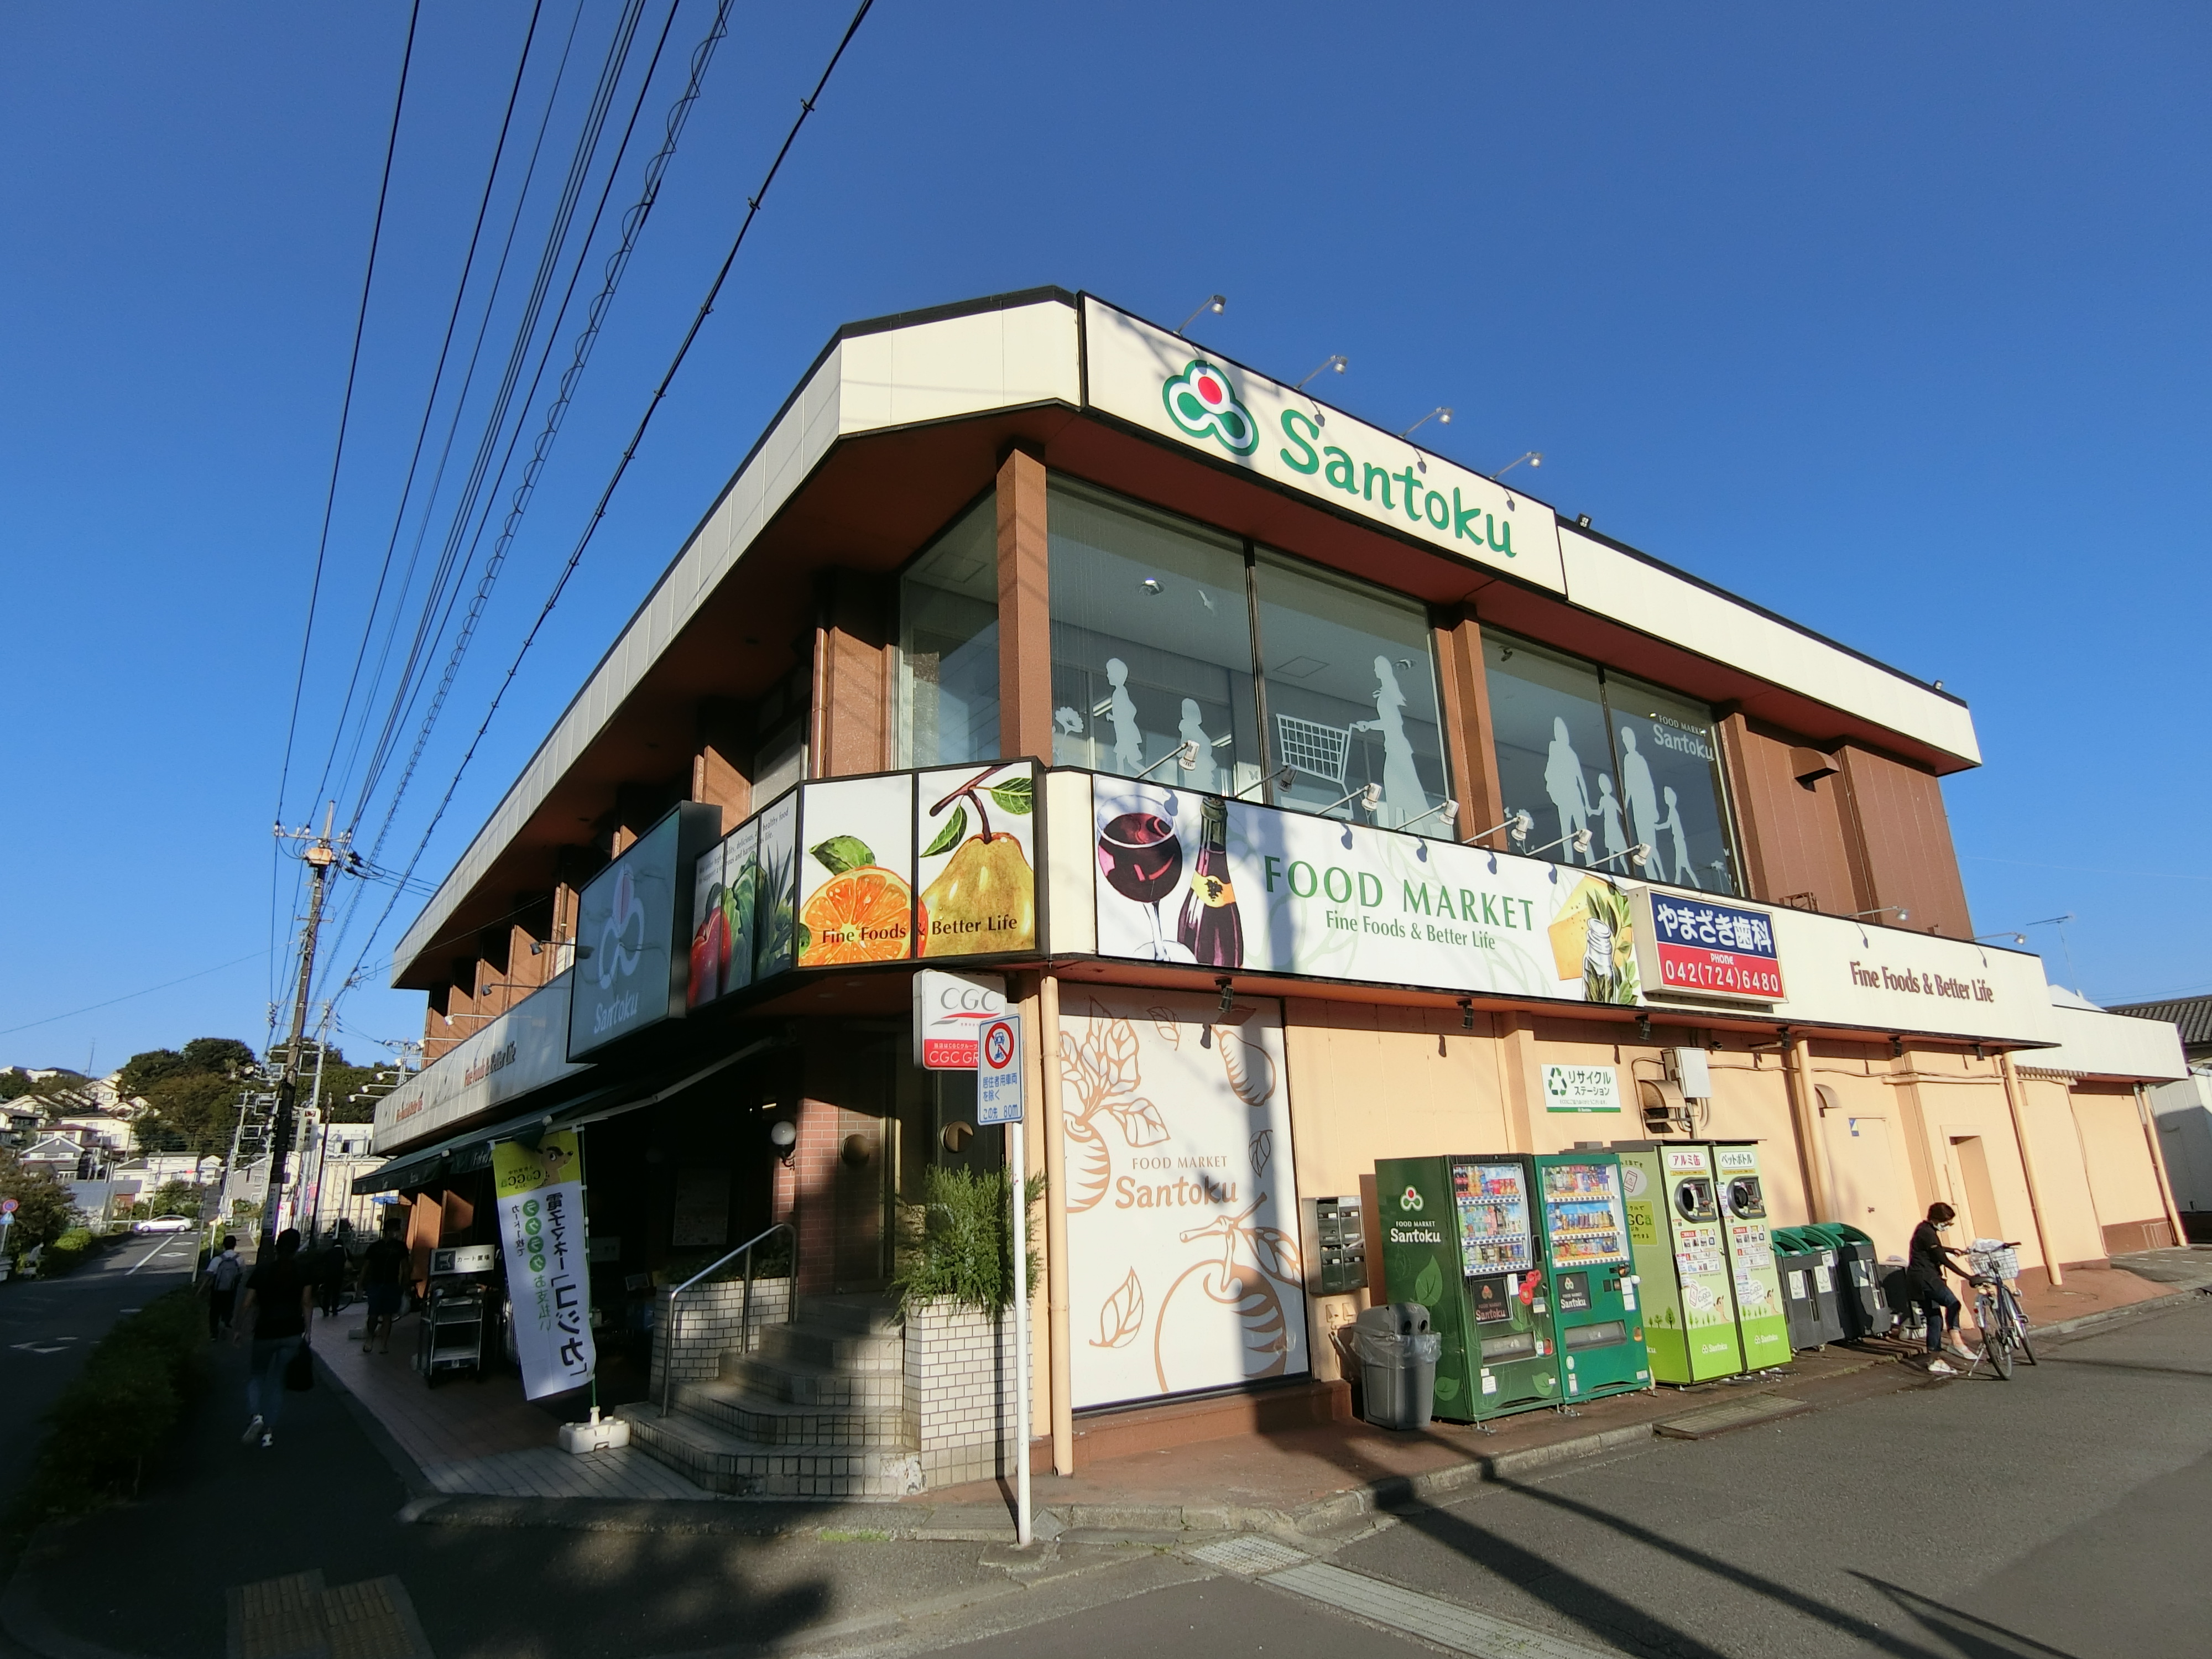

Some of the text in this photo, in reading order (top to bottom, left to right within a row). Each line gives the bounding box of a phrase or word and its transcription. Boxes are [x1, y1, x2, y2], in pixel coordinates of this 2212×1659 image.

[1280, 409, 1517, 558] Santoku
[1658, 714, 1679, 728] FOOD
[1653, 724, 1715, 761] Santoku
[1264, 855, 1533, 931] FOOD MARKET
[822, 914, 1018, 943] Fine Foods & Better Life
[1326, 910, 1495, 950] Fine Foods & Better Life
[1657, 903, 1772, 953] やまざき歯科
[1665, 959, 1779, 993] 042(724)6480
[1850, 961, 1994, 1003] Fine Foods & Better Life
[941, 987, 998, 1011] CGC
[594, 990, 639, 1034] Santoku
[929, 1051, 960, 1063] CGC
[983, 1073, 1018, 1088] 居住者用車両
[1568, 1070, 1611, 1084] リサイクル
[983, 1089, 1000, 1102] を除く
[1574, 1086, 1610, 1095] ステーション
[983, 1104, 1018, 1119] この先 80m
[1133, 1156, 1227, 1170] FOOD MARKET
[1673, 1154, 1700, 1166] アルミ缶
[1721, 1154, 1752, 1165] ペットボトル
[1115, 1175, 1239, 1209] Santoku
[1390, 1228, 1441, 1243] Santoku
[1561, 1298, 1587, 1309] Santoku
[1476, 1308, 1506, 1321] Santoku
